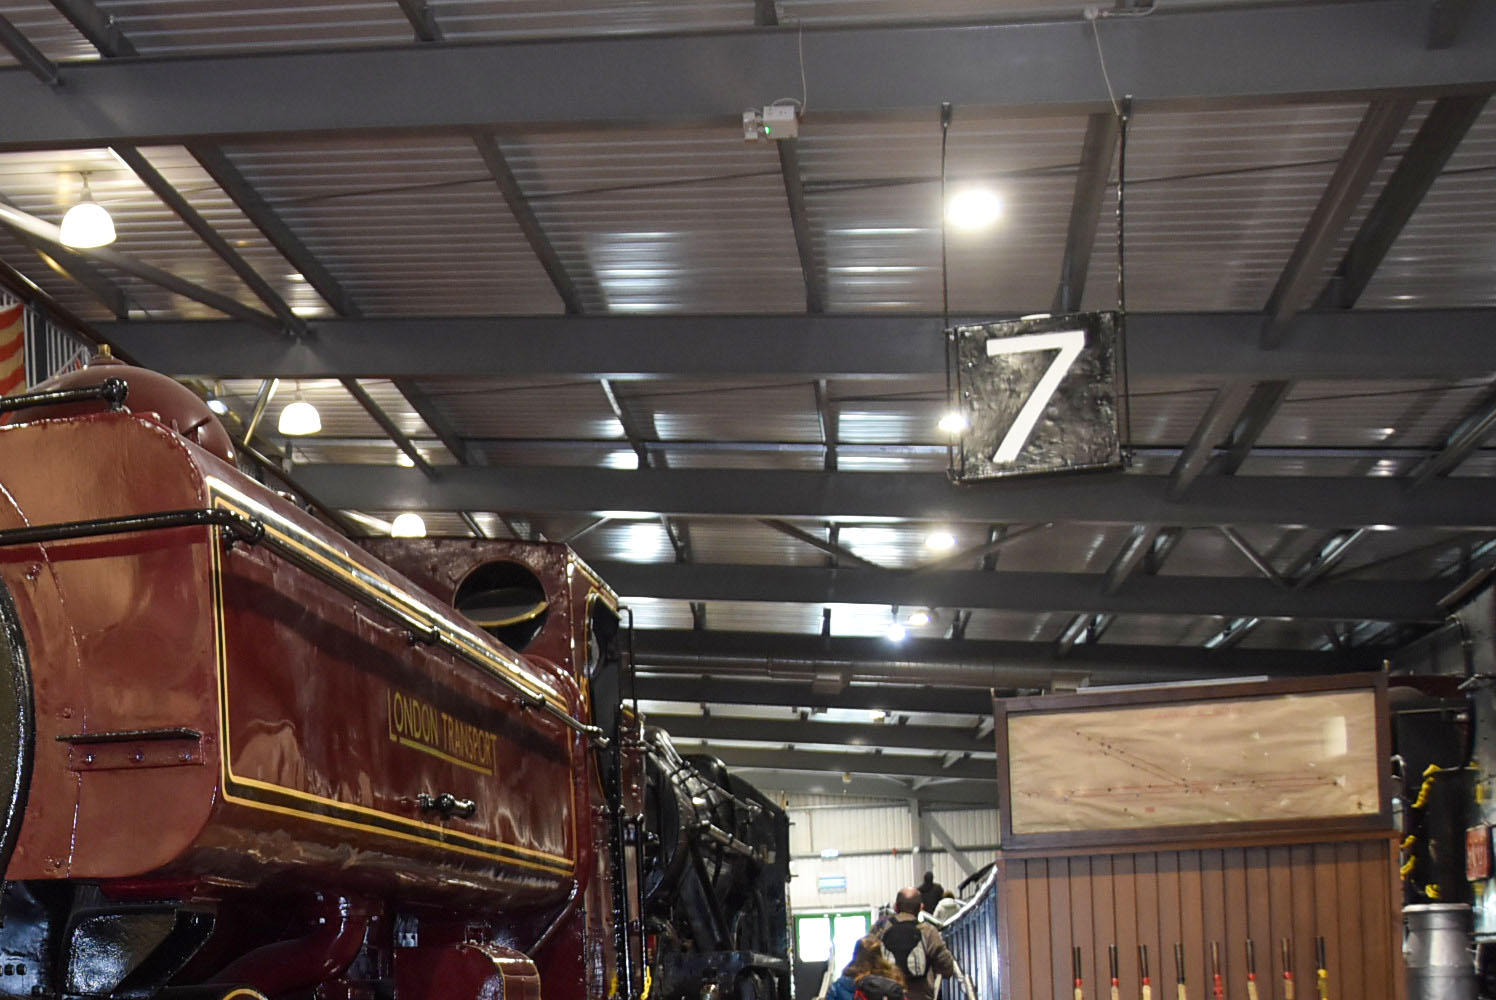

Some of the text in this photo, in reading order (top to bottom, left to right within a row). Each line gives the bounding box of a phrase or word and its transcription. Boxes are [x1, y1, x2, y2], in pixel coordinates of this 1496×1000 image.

[986, 329, 1086, 464] 7
[386, 688, 498, 776] LONDON TRANSPORT
